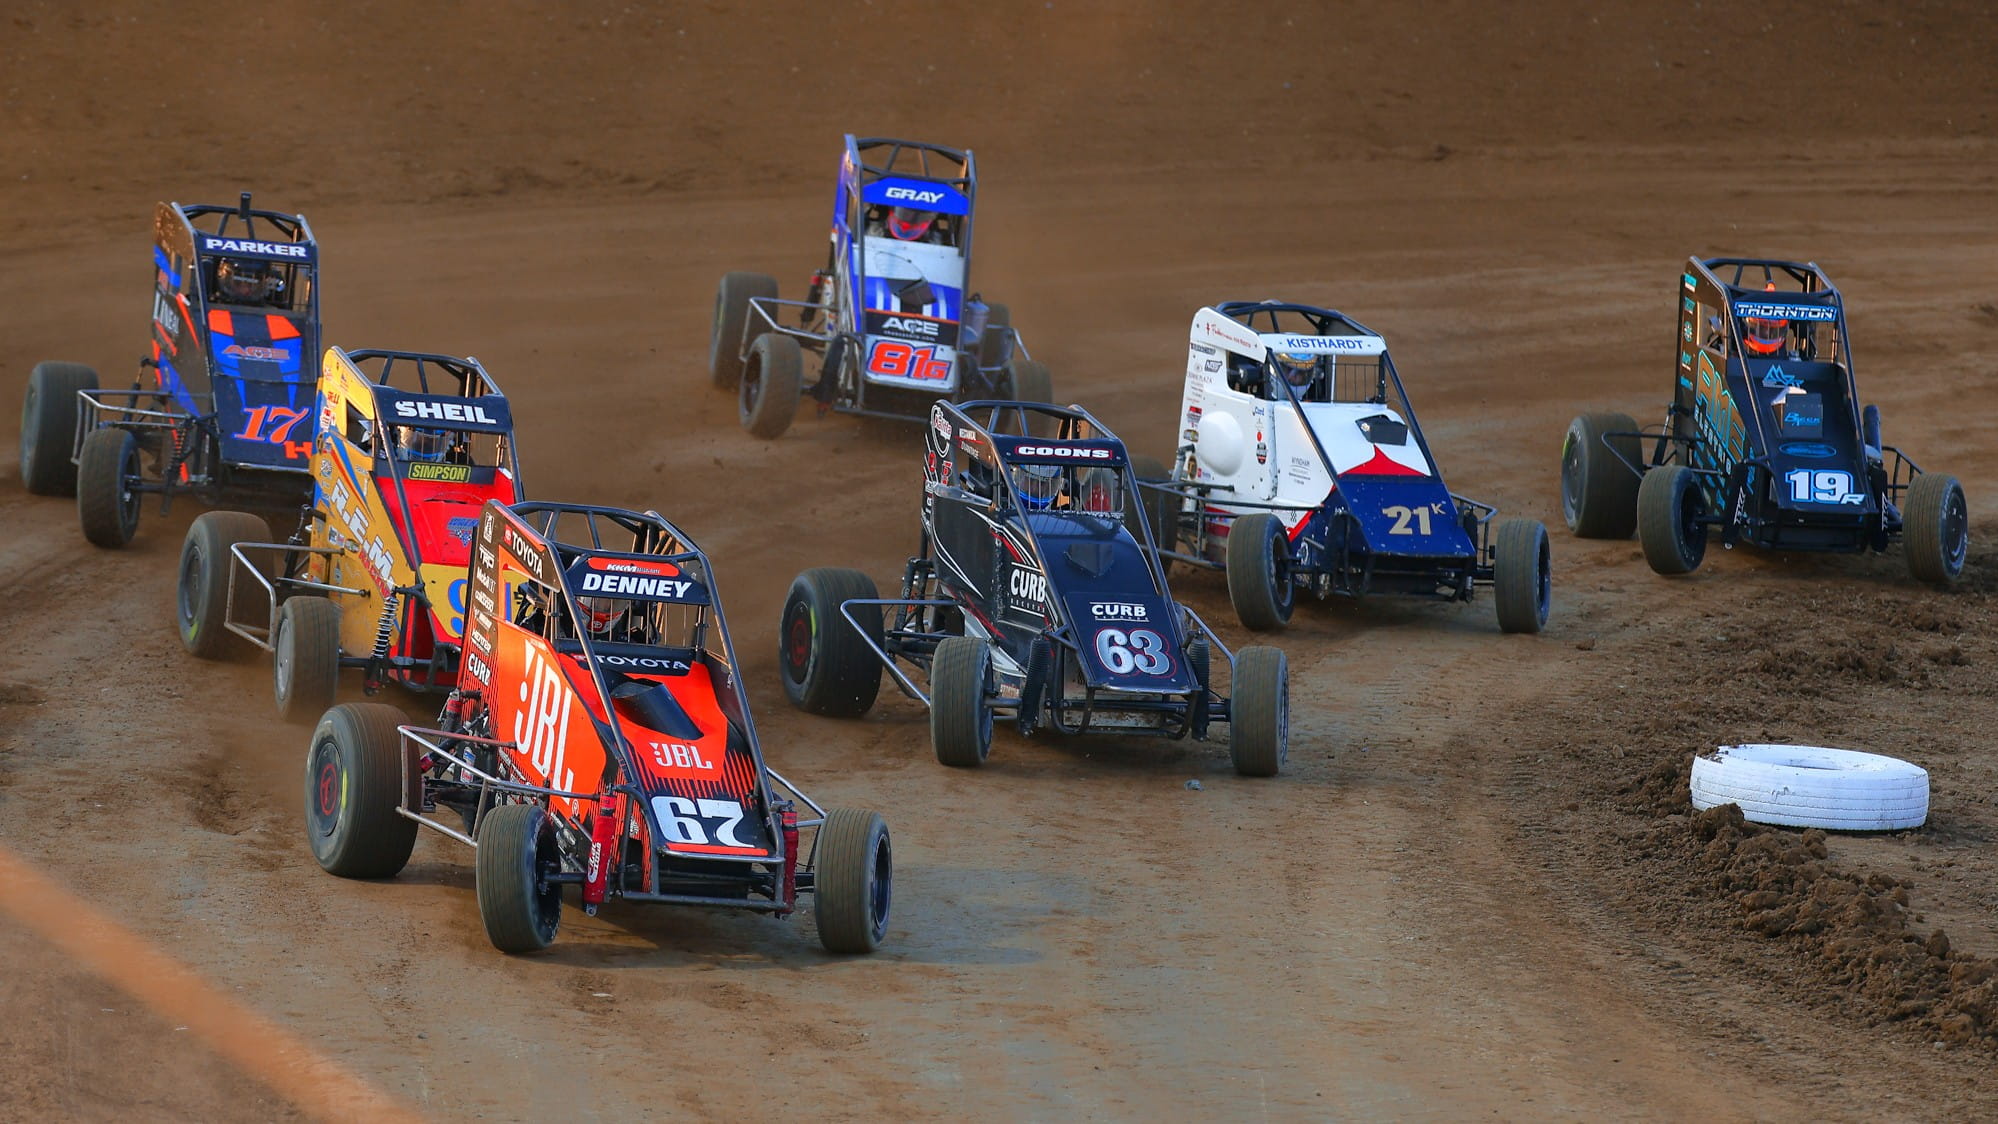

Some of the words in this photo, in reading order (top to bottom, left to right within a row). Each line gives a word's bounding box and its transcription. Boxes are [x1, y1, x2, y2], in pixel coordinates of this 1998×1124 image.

[885, 187, 945, 203] GRAY
[206, 239, 307, 257] PARKER
[1737, 303, 1835, 319] THORNTON
[882, 317, 939, 336] ACE
[222, 345, 290, 360] ACE
[1286, 338, 1364, 350] KISTHARDT
[394, 400, 497, 424] SHEIL
[1017, 446, 1110, 459] COONS
[411, 464, 467, 481] SIMPSON
[511, 531, 544, 580] TOYOTA
[606, 563, 637, 573] KKM
[582, 573, 692, 598] DENNEY
[1010, 568, 1046, 603] CURB
[1091, 604, 1147, 617] CURB
[1095, 627, 1170, 675] 63
[595, 655, 690, 670] TOYOTA
[514, 640, 574, 806] JBL
[650, 742, 713, 770] JBL
[651, 796, 756, 849] 67
